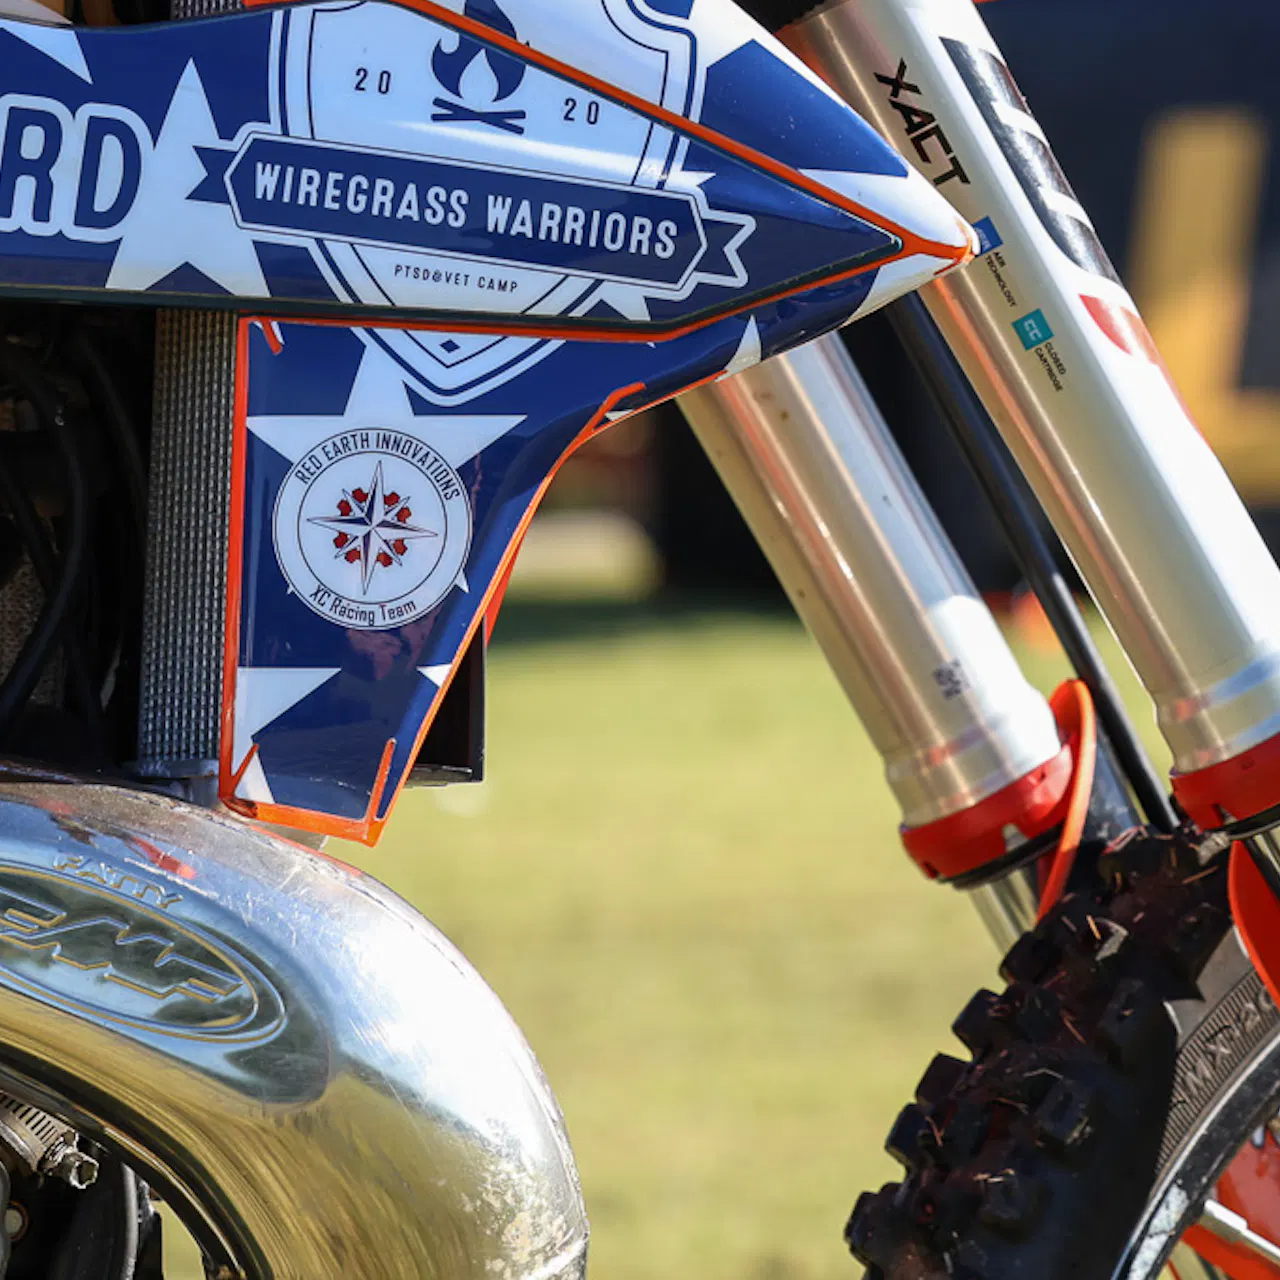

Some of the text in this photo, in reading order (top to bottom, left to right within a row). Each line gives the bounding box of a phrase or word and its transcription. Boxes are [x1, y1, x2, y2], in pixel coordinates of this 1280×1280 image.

[354, 67, 391, 95] 20
[563, 97, 600, 126] 20
[874, 57, 971, 187] XACT
[255, 161, 678, 259] WIREGRASS WARRIORS
[477, 276, 519, 294] CAMP
[984, 256, 1017, 308] TECHNOLOGY
[1034, 348, 1064, 393] CARTRIDGE
[1043, 342, 1067, 376] CLOSED
[295, 432, 461, 501] RED EARTH INNOVATIONS
[309, 584, 417, 626] XC Racing Team
